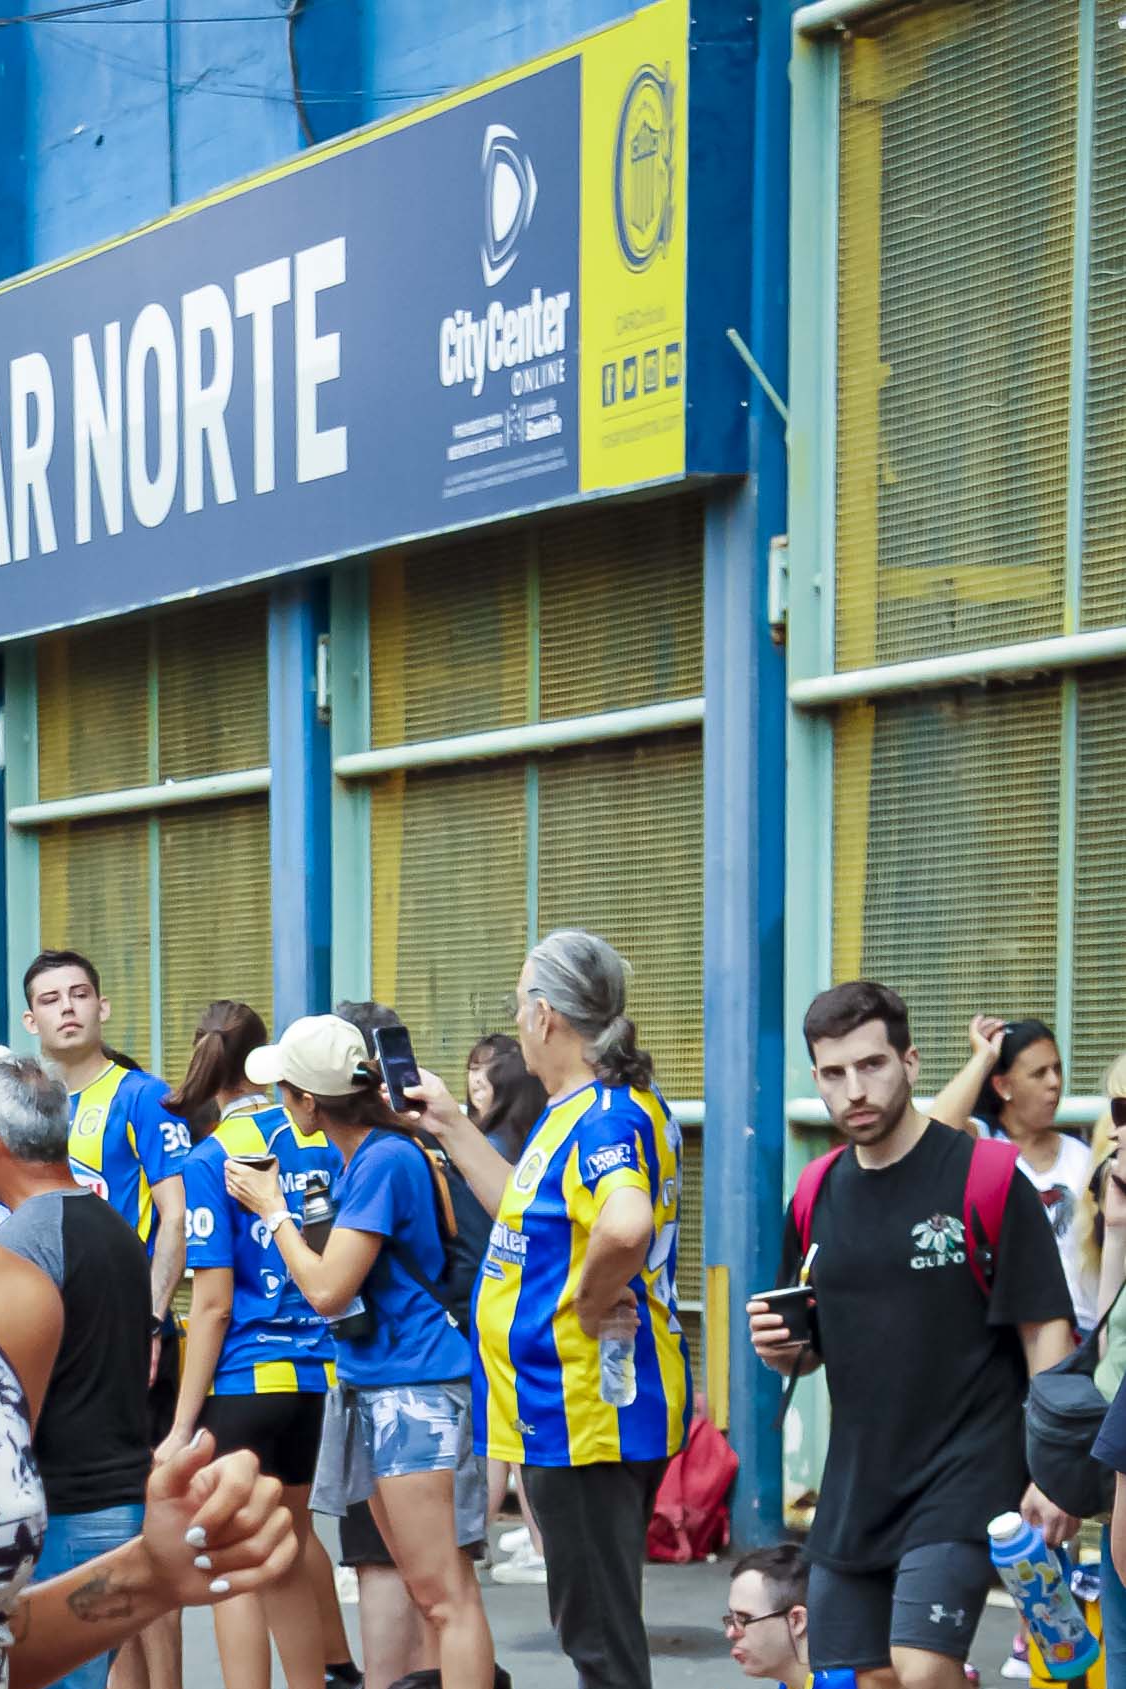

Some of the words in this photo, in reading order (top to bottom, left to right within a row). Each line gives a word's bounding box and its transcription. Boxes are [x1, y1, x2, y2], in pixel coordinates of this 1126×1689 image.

[75, 236, 348, 546] NORTE
[510, 358, 566, 397] ONLINE
[159, 1121, 192, 1151] 30
